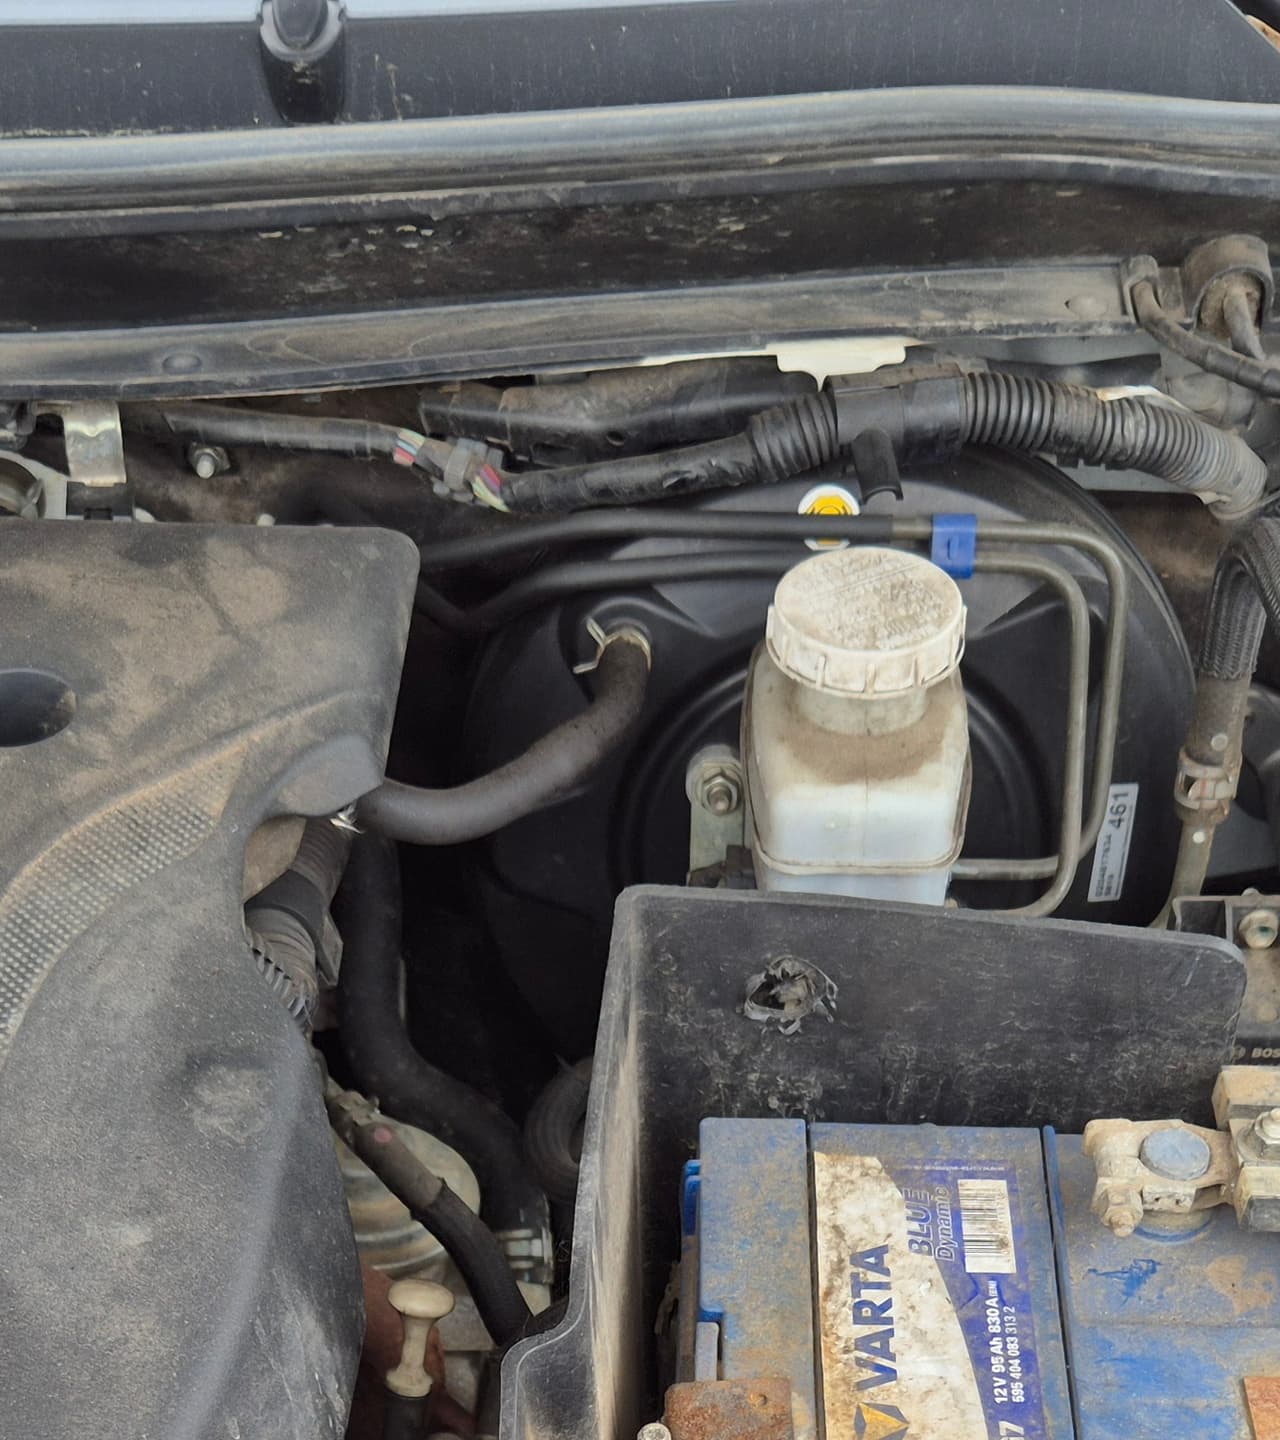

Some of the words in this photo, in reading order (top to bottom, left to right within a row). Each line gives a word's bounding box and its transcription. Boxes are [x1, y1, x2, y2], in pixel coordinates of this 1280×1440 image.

[1108, 792, 1129, 829] 461
[901, 1187, 934, 1257] BLUE
[934, 1186, 958, 1261] Dynamic
[849, 1243, 898, 1392] VARTA
[1003, 1305, 1016, 1314] 2
[1004, 1316, 1017, 1334] 313
[1008, 1359, 1021, 1380] 404
[993, 1376, 1009, 1404] 12V
